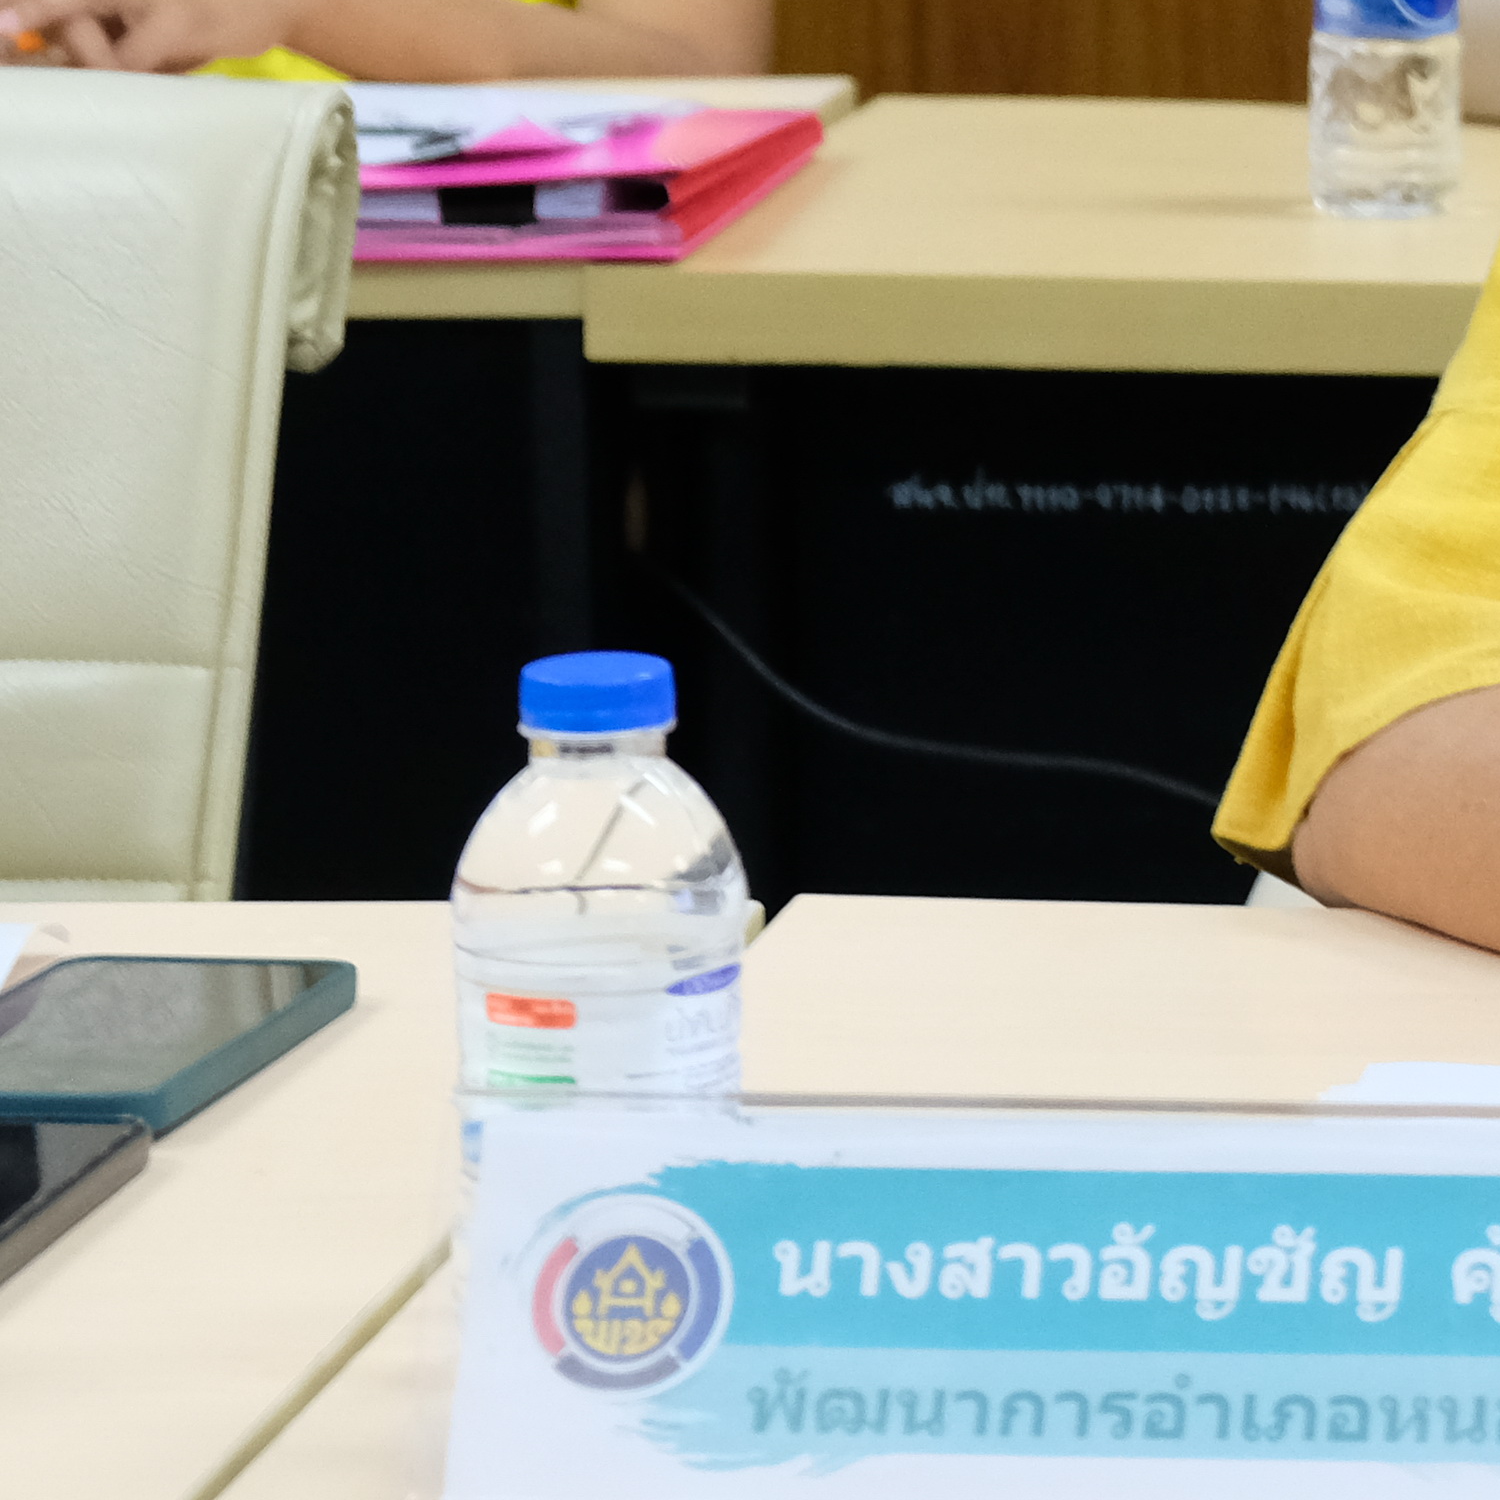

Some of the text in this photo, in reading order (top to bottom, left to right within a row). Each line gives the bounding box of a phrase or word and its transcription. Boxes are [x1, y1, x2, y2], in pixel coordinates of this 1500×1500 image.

[771, 1220, 1405, 1322] นางสาวอัญชัญ
